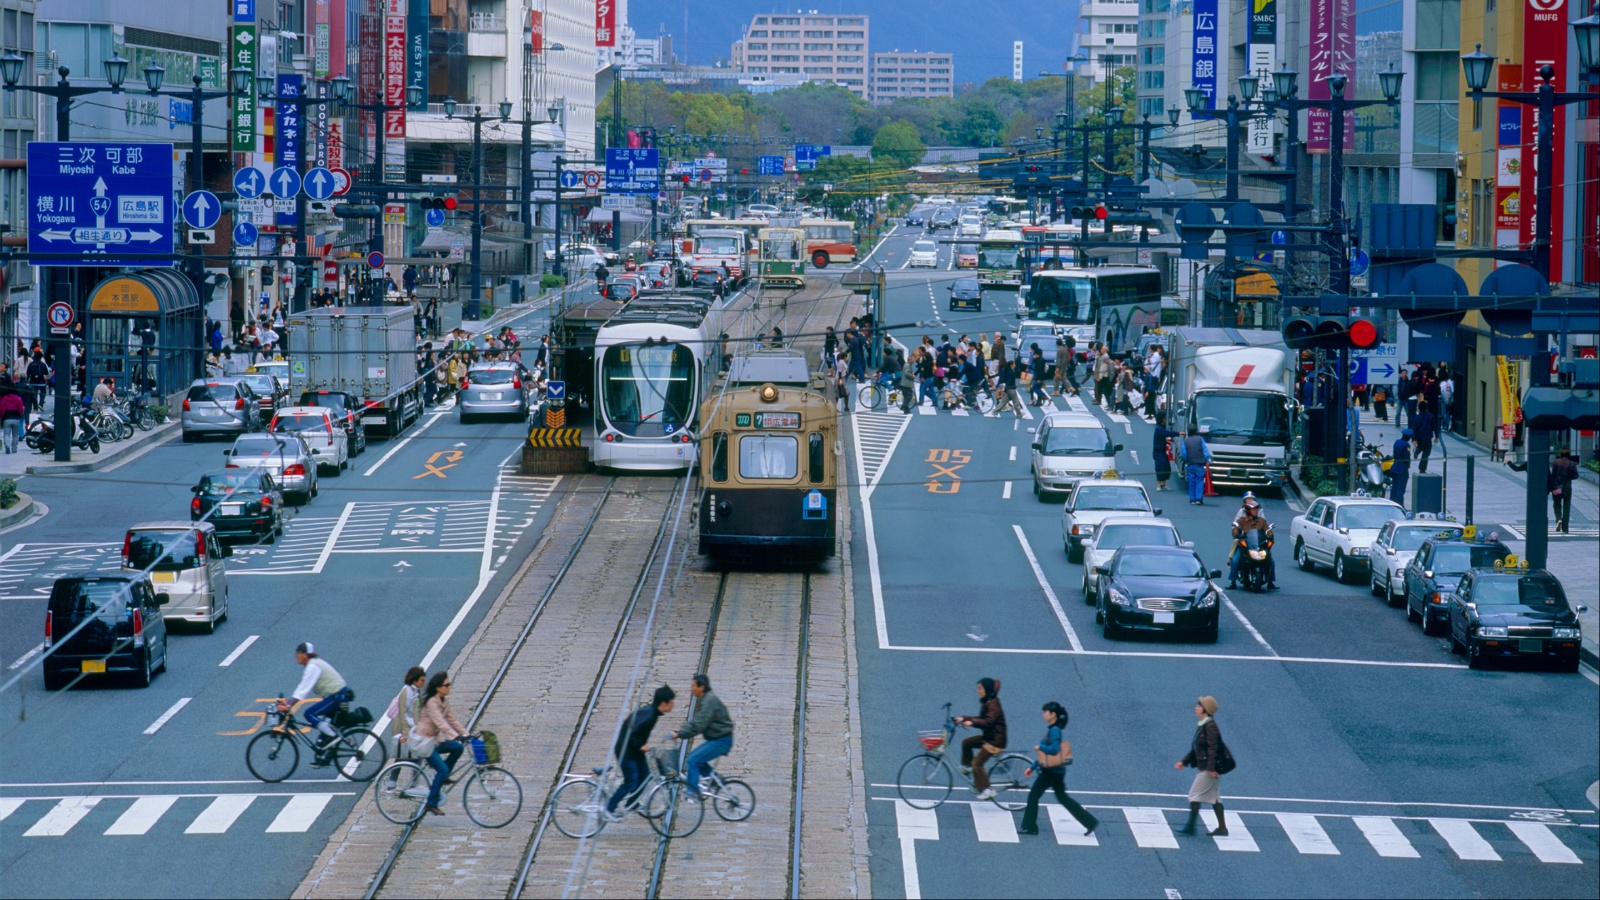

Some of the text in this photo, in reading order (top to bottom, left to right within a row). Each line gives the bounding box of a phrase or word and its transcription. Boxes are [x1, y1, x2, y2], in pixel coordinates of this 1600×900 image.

[414, 35, 422, 67] WEST
[1196, 12, 1214, 98] 広島銀行
[283, 104, 297, 169] メガネの三
[58, 147, 142, 164] 三次 可部
[60, 165, 136, 175] Miyoshi Kabe
[37, 196, 75, 212] 横川
[94, 200, 107, 210] 54
[122, 201, 159, 211] 広島駅
[37, 214, 75, 224] Yokogawa
[79, 231, 122, 241] 相生通り
[325, 267, 336, 275] JTB
[112, 294, 138, 302] 本通駅
[1376, 345, 1397, 356] 原付
